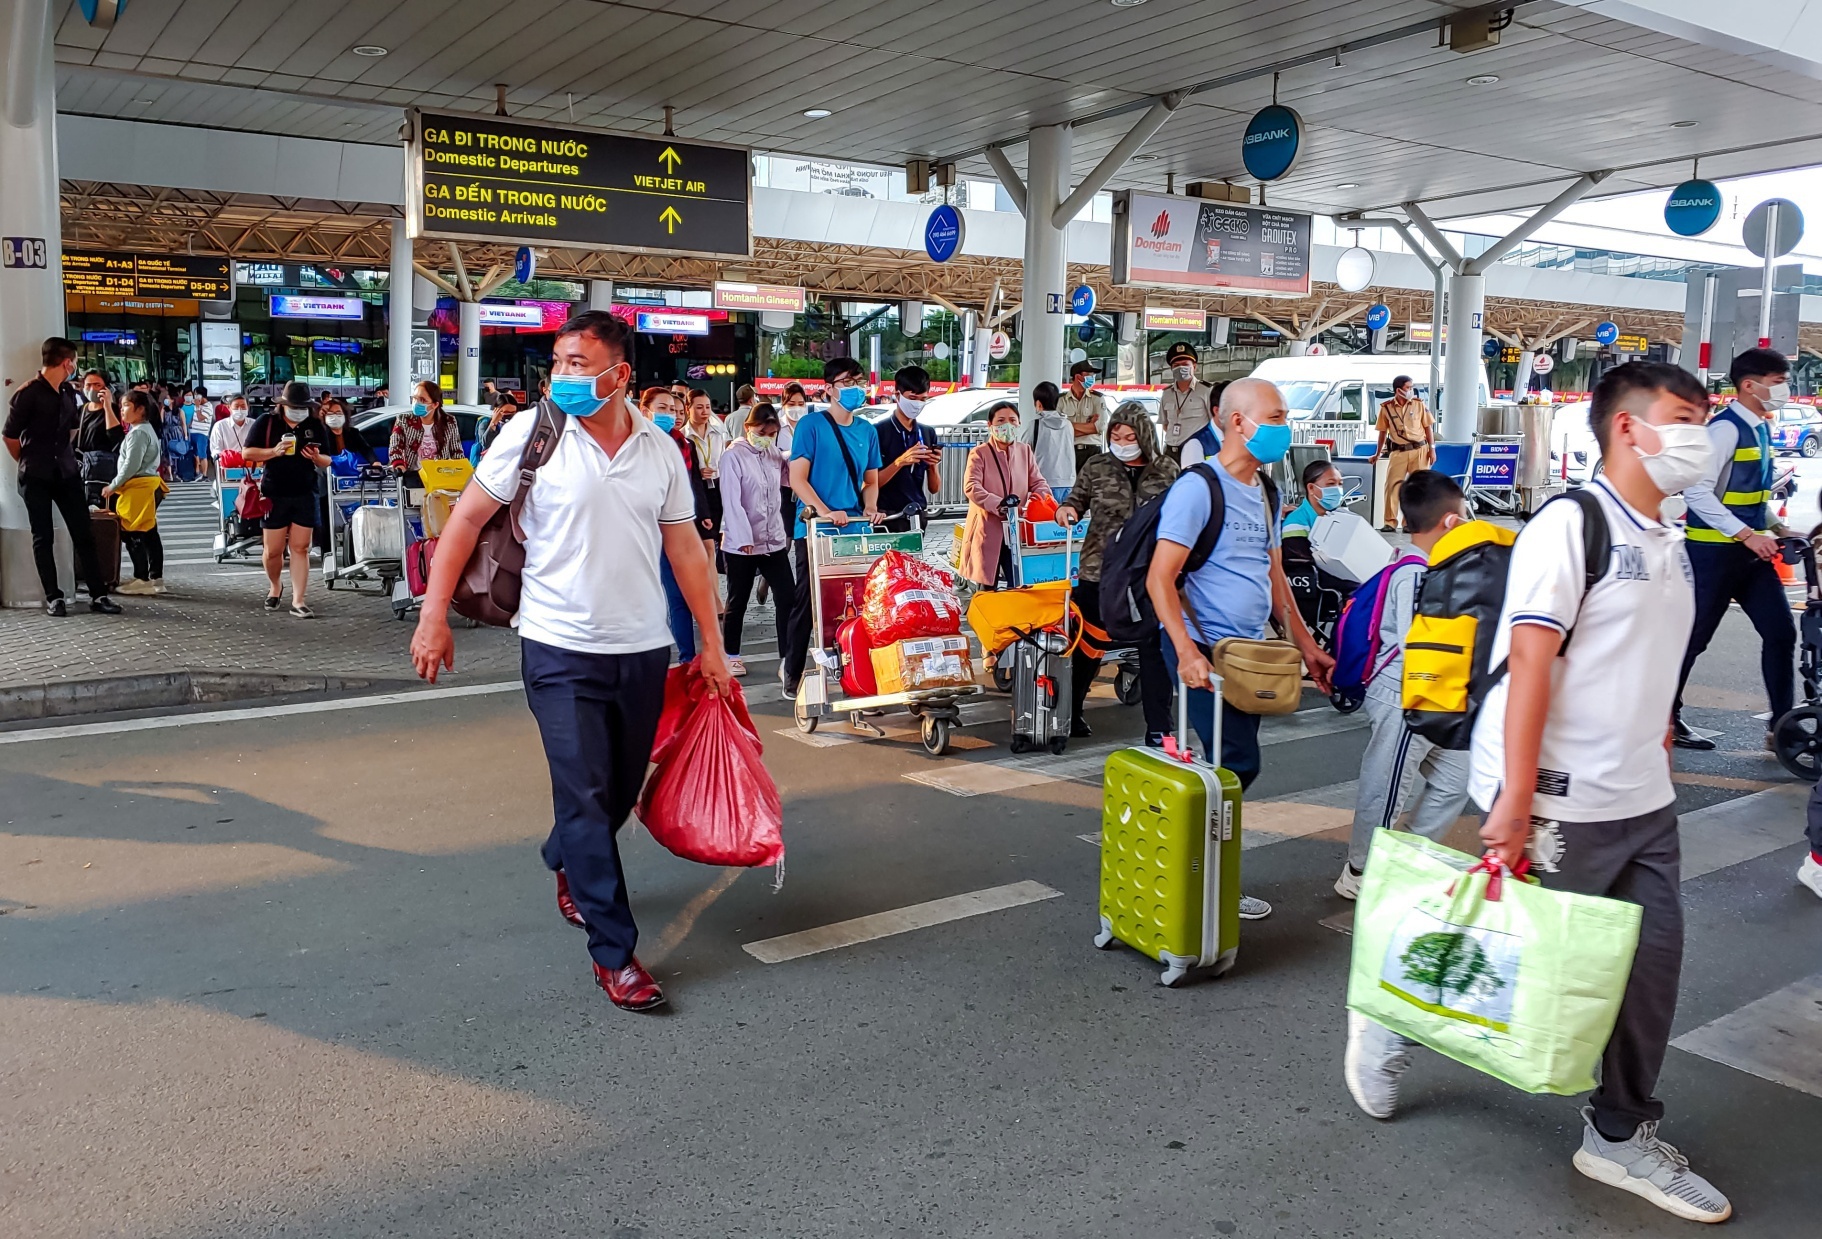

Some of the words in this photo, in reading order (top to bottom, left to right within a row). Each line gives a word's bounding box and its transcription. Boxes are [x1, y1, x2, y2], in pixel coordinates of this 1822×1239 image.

[424, 128, 450, 144] GA
[455, 131, 472, 146] ĐI
[477, 133, 536, 152] TRONG
[542, 139, 588, 158] NƯỚC
[424, 148, 496, 167] Domestic
[500, 156, 579, 175] Departures
[633, 174, 683, 191] VIETJET
[686, 176, 706, 193] AIR
[424, 184, 450, 199] GA
[455, 182, 492, 203] ĐẾN
[497, 190, 556, 208] TRONG
[561, 194, 607, 212] NƯỚC
[425, 204, 496, 222] Domestic
[500, 210, 557, 226] Arrivals
[1212, 216, 1250, 234] GECKO
[1262, 228, 1296, 245] GROUTEX
[1134, 236, 1182, 252] Dongtam
[2, 239, 46, 267] B-03
[106, 259, 133, 269] A1-A3
[106, 278, 134, 286] D1-D4
[190, 282, 216, 290] D5-D8
[303, 302, 345, 310] VIETBANK
[722, 292, 764, 304] Homtamin
[766, 296, 800, 307] Ginseng
[1073, 298, 1085, 307] VIB
[489, 310, 526, 318] VIETBANK
[1597, 330, 1609, 338] VIB
[669, 343, 688, 354] GUSTO
[1640, 337, 1646, 351] B
[1476, 465, 1499, 474] BIDV
[855, 543, 892, 552] HBECO
